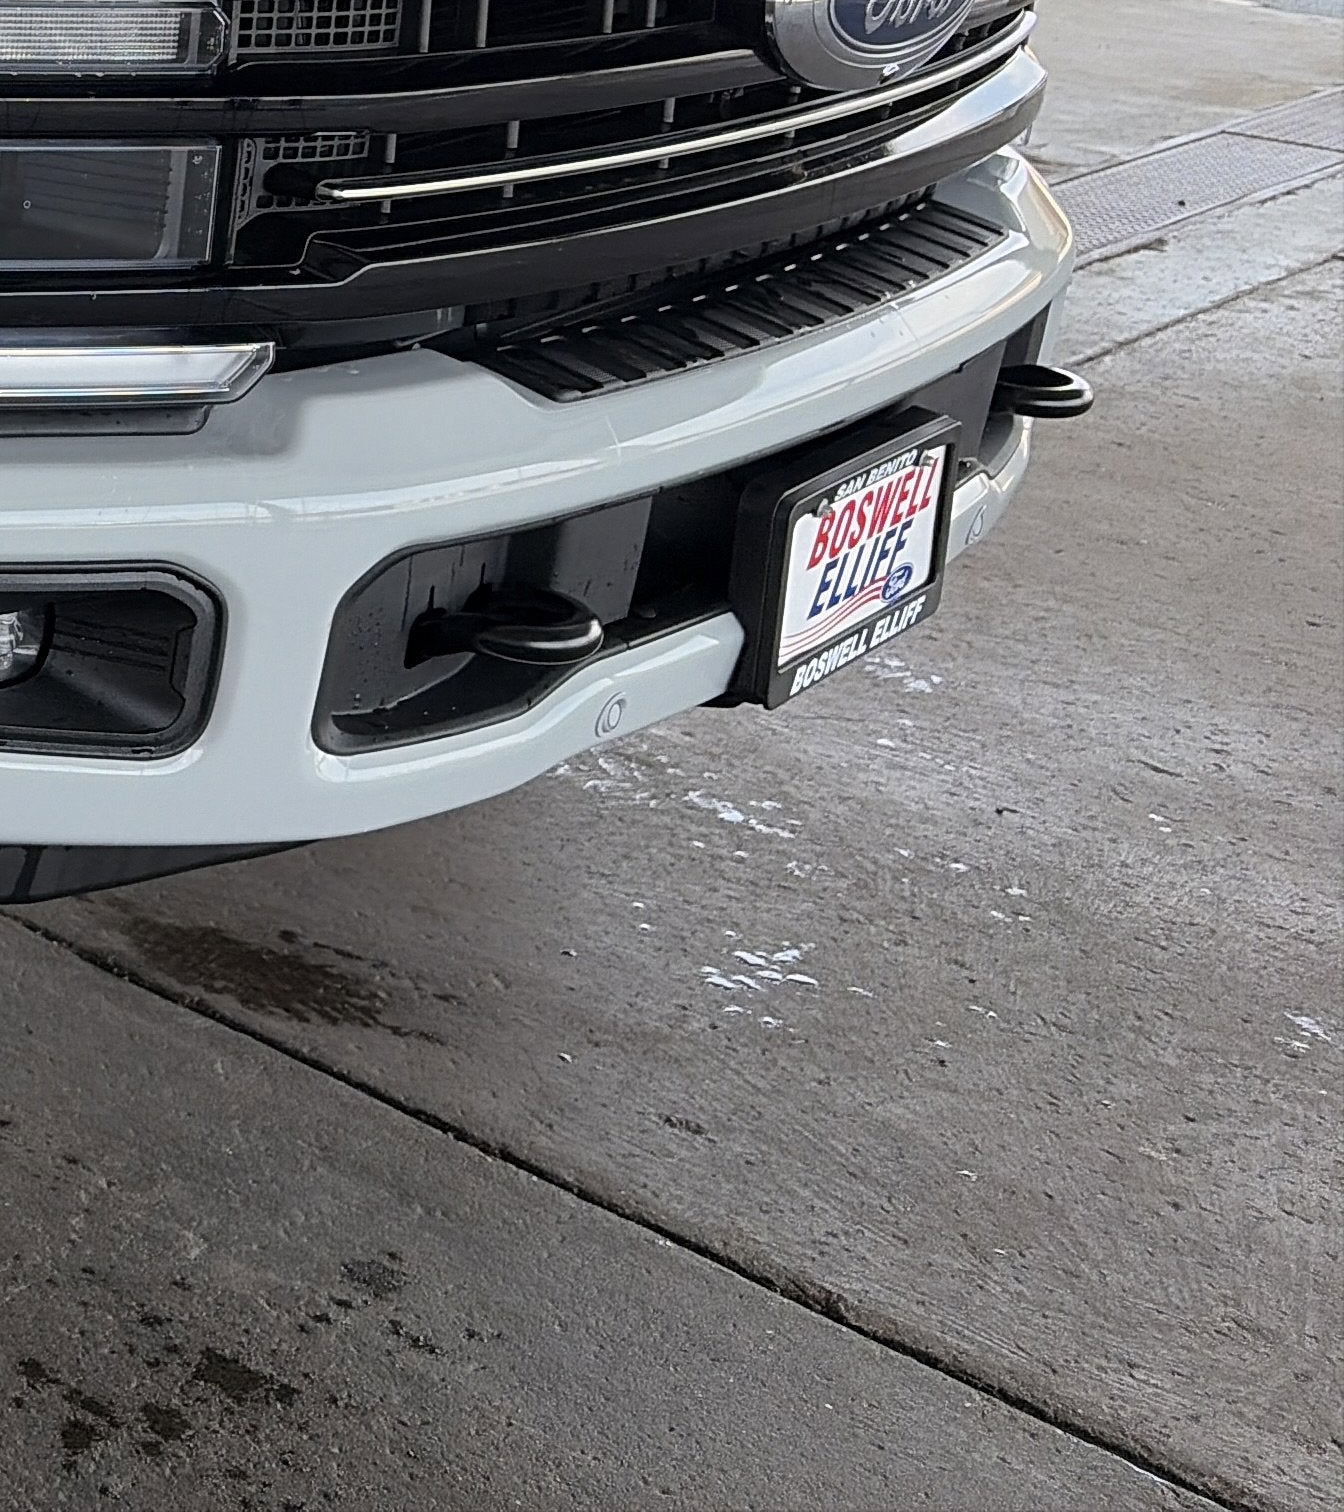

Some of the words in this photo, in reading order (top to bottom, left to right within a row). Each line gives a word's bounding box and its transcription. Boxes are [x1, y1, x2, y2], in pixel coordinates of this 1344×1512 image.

[807, 457, 940, 570] BOSWELL
[834, 473, 867, 502] SAN
[865, 449, 918, 487] BENITO
[807, 517, 915, 620] ELLIFF
[789, 628, 868, 696] BOSWELL
[869, 594, 927, 648] ELLIFF
